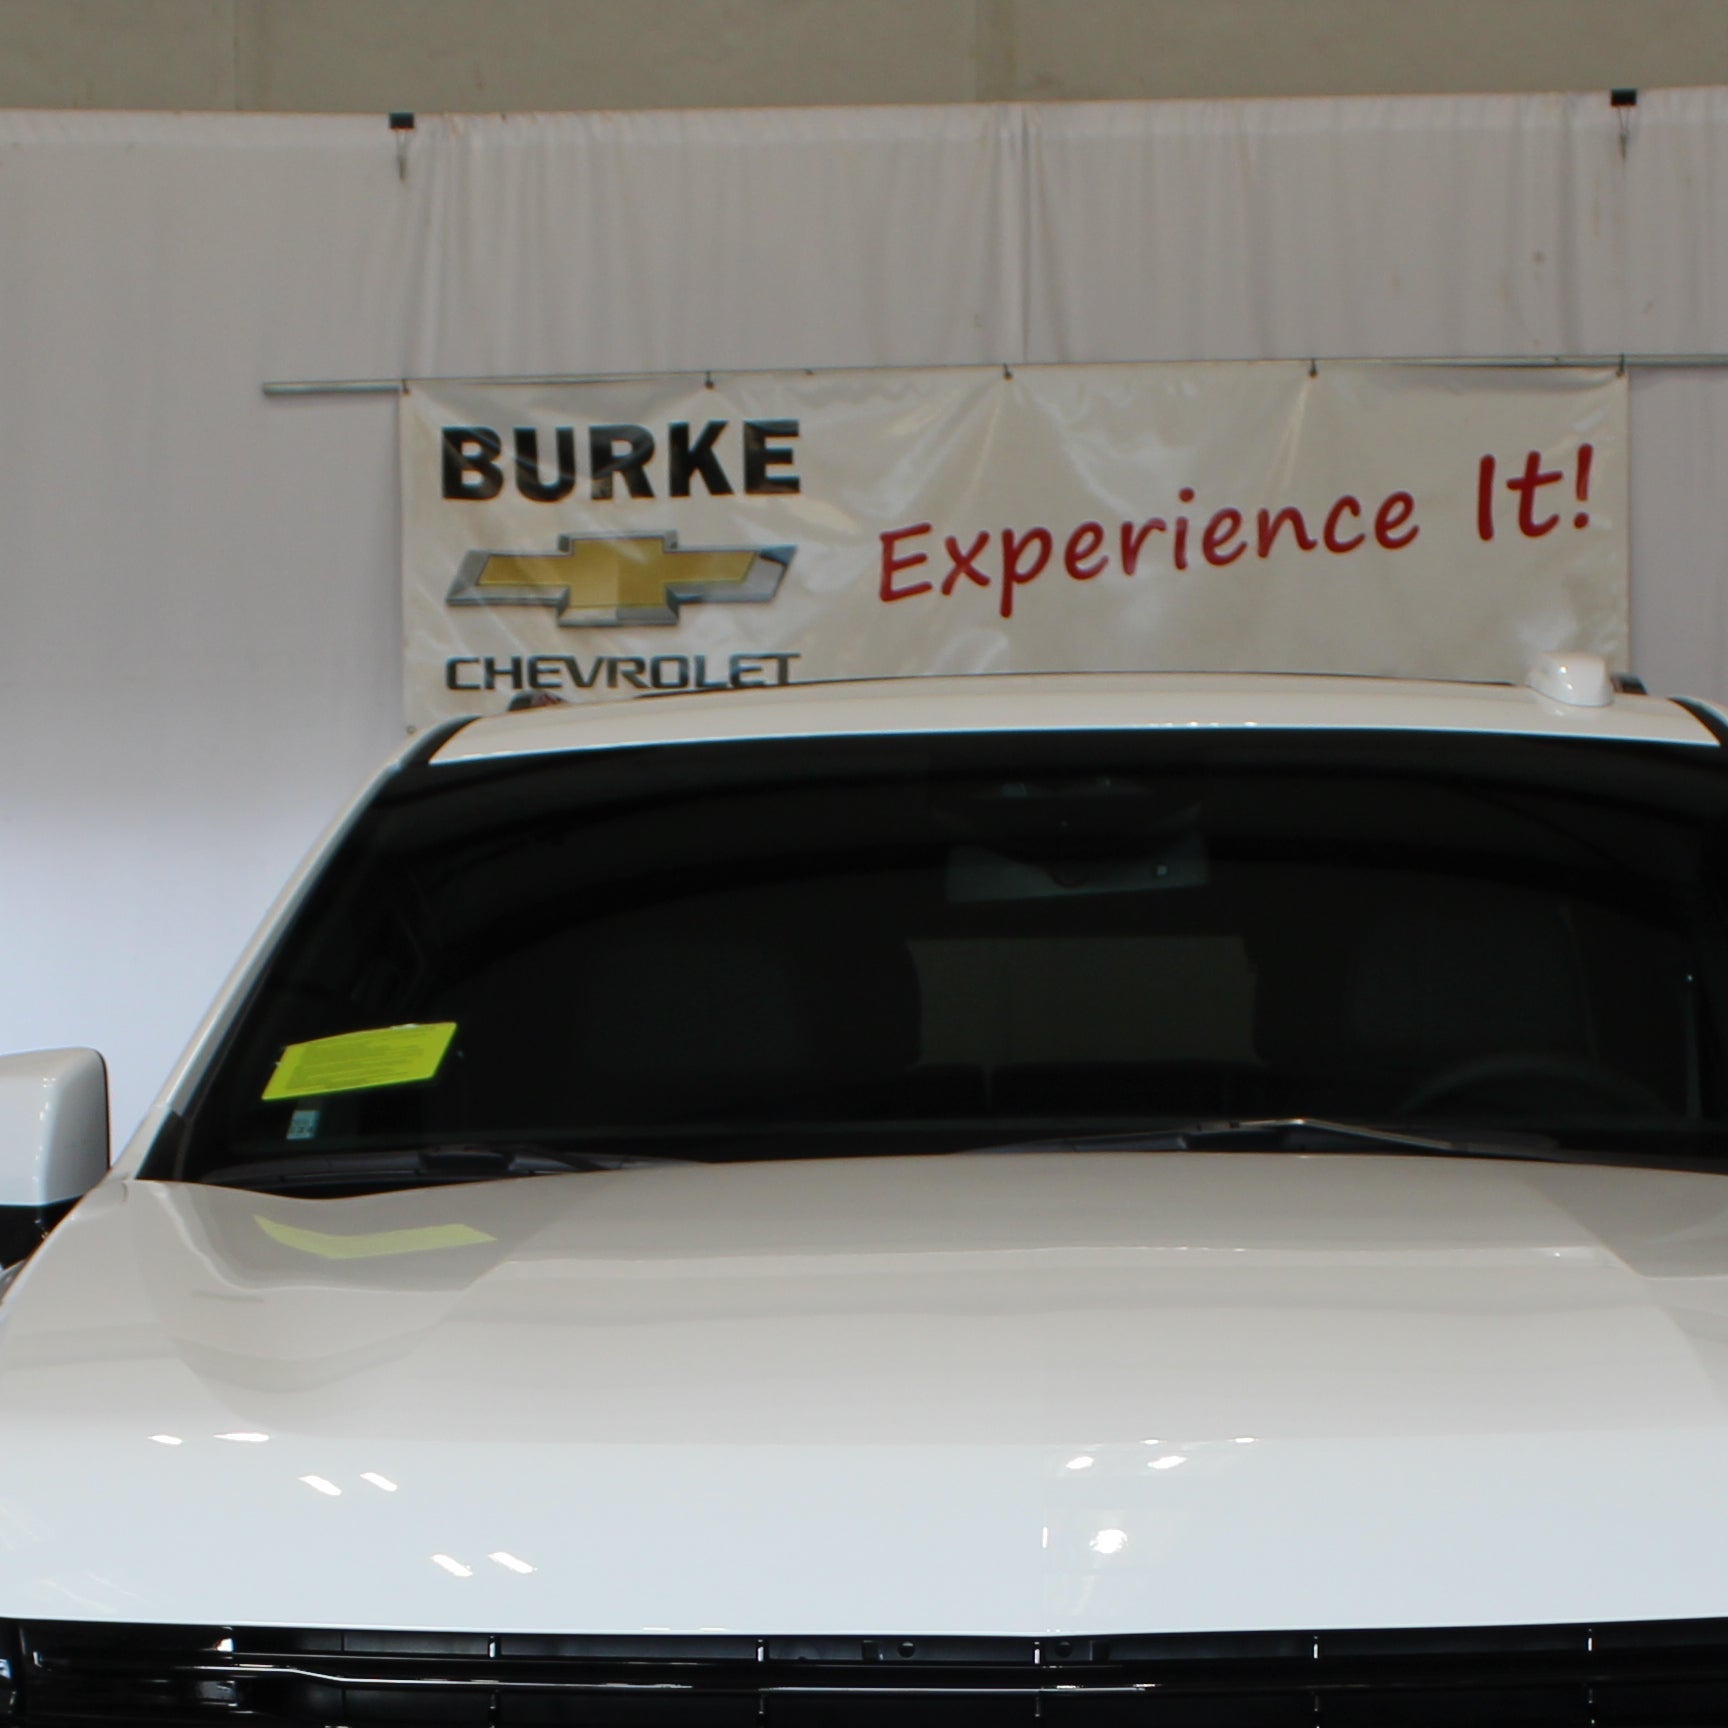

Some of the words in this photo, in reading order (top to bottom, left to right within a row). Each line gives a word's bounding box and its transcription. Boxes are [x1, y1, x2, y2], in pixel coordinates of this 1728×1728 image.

[441, 419, 801, 502] BURKE
[878, 488, 1419, 618] Experience
[1476, 442, 1594, 542] It!
[445, 652, 802, 692] CHEVROLET
